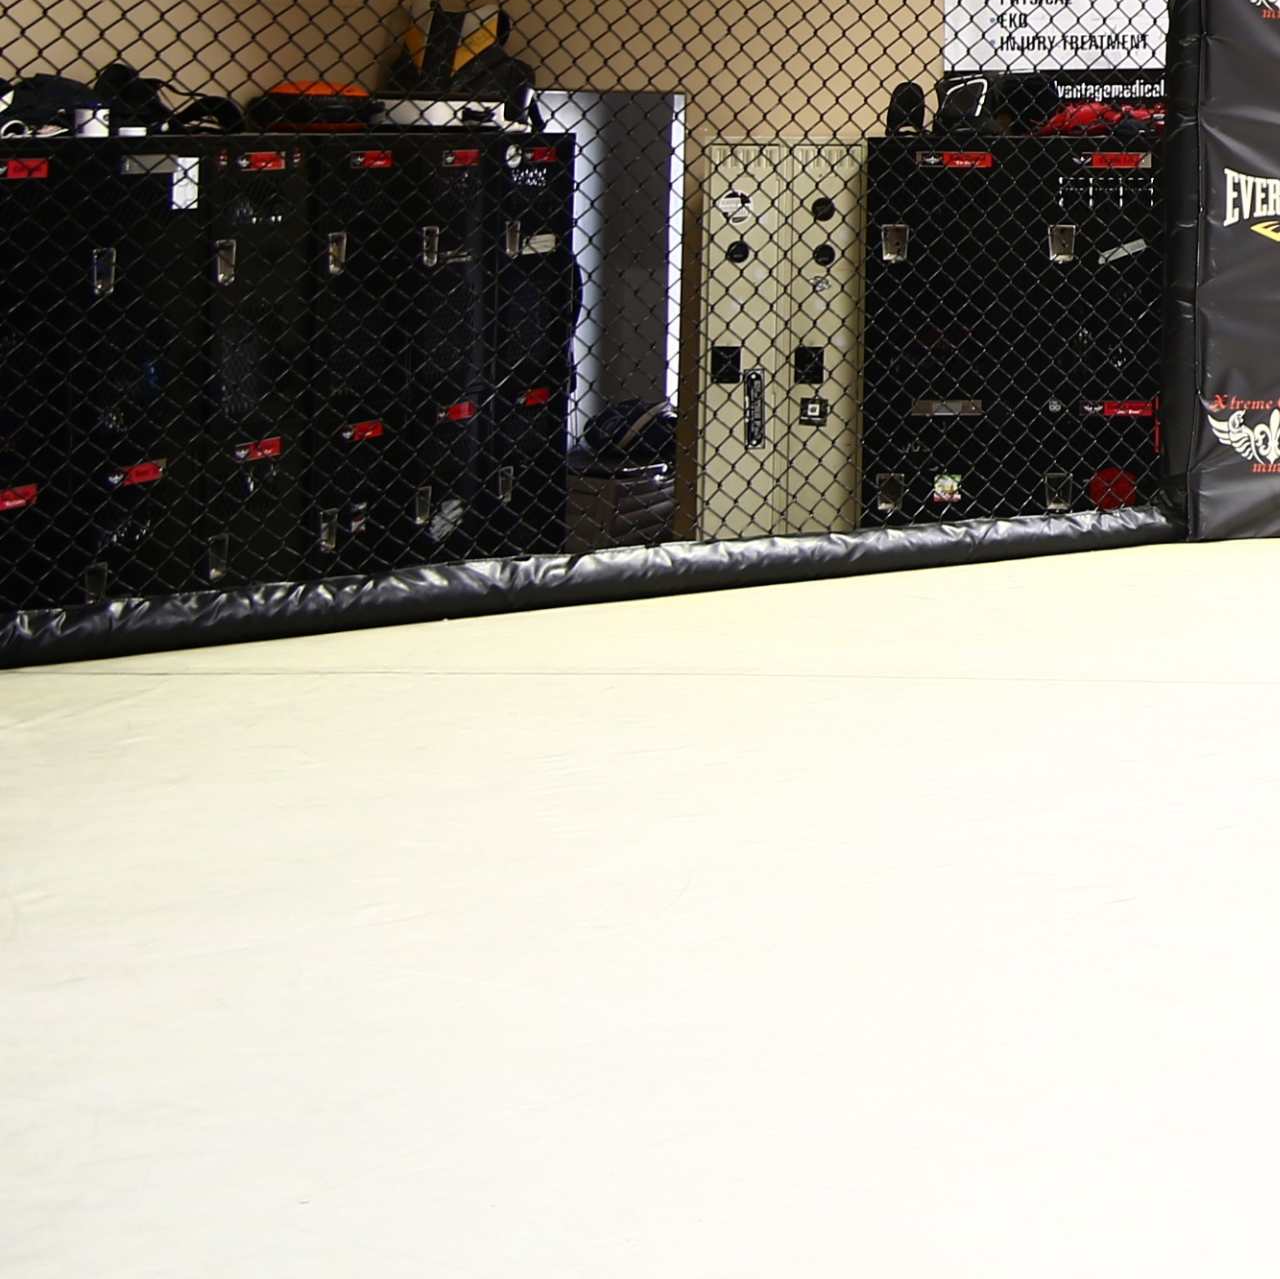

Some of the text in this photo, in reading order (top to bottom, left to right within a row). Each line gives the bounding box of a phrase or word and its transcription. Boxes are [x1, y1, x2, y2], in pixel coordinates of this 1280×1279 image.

[1000, 33, 1150, 52] INJURY TREATMENT
[1053, 79, 1168, 102] vantagemedical
[1208, 392, 1275, 413] Xtreme
